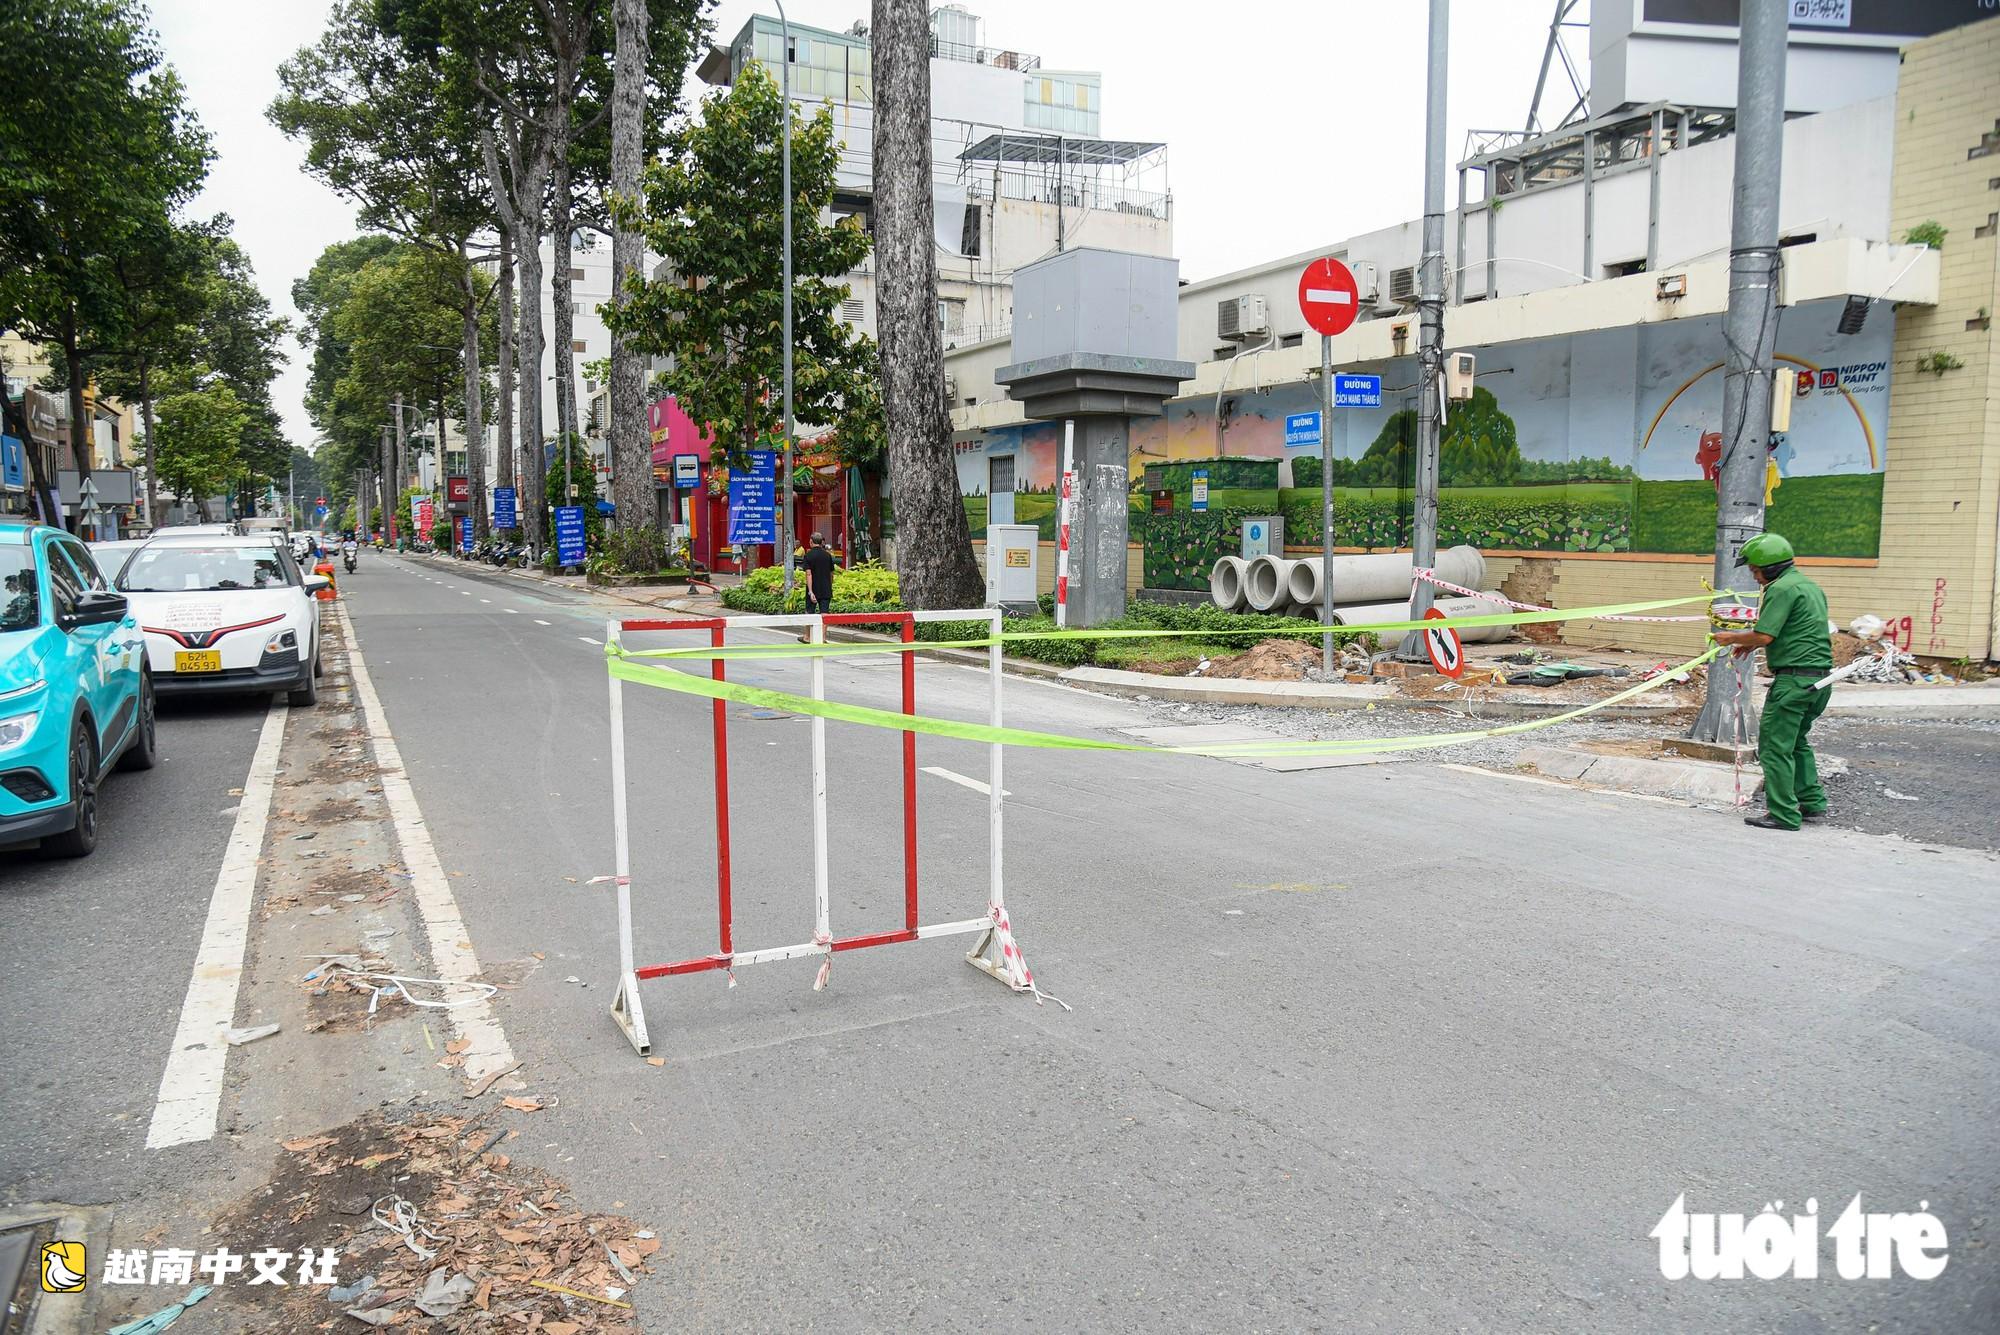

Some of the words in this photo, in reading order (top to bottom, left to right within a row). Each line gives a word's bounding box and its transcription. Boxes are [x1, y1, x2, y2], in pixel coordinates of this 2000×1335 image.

[1840, 362, 1886, 374] NIPPON
[1344, 378, 1371, 389] ĐƯỜNG
[1842, 373, 1878, 384] PAINT
[1336, 392, 1347, 404] CÁCH
[1362, 392, 1375, 405] THÁNG
[1293, 417, 1313, 428] ĐƯỜNG
[187, 652, 208, 661] 62H
